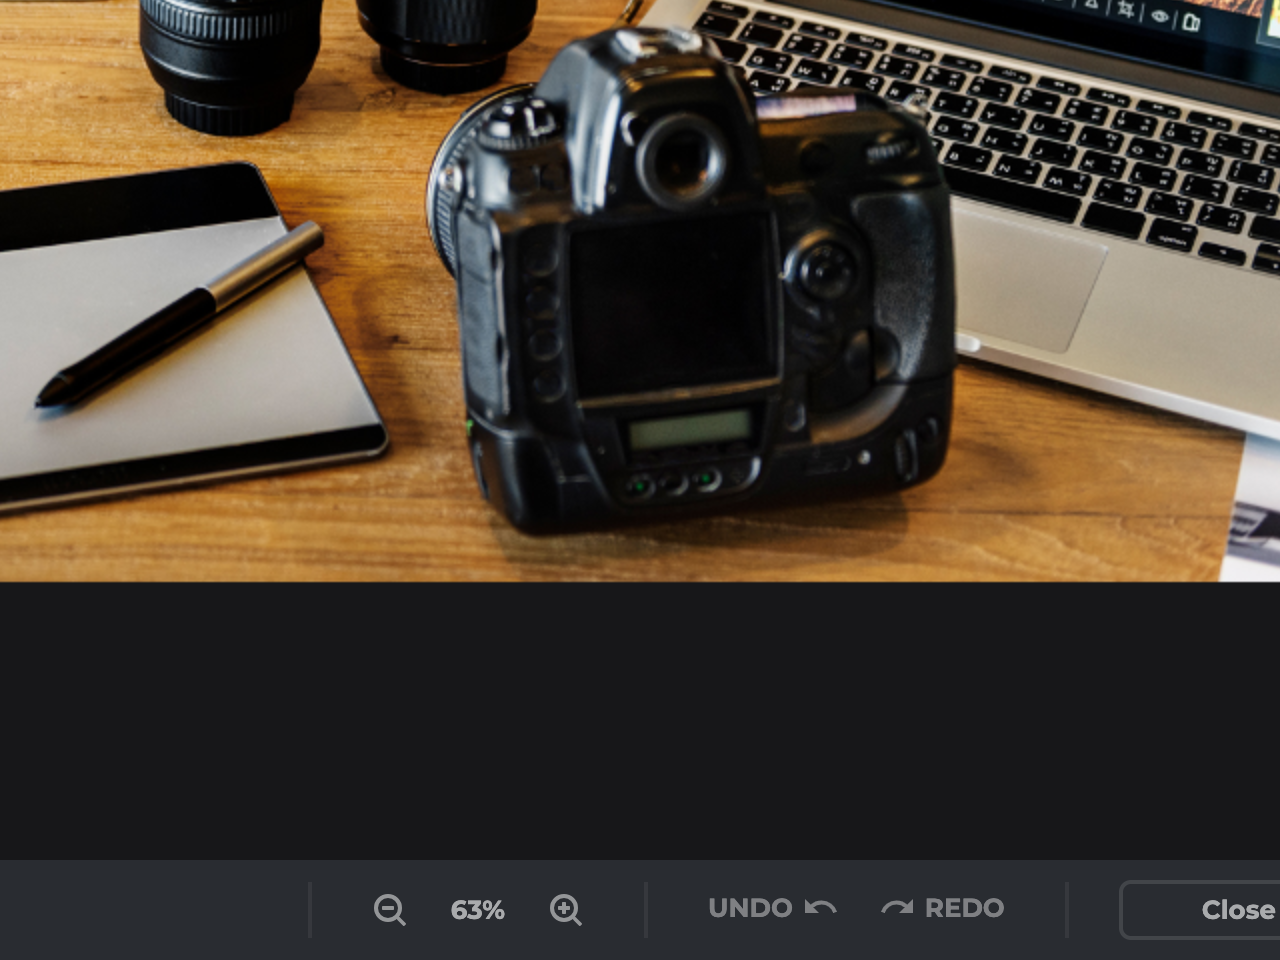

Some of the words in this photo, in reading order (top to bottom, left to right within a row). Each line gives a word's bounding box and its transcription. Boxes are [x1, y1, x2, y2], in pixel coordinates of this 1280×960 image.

[451, 900, 505, 920] 63%
[710, 898, 792, 917] UNDO
[927, 898, 1004, 917] REDO
[1202, 899, 1276, 920] Close
